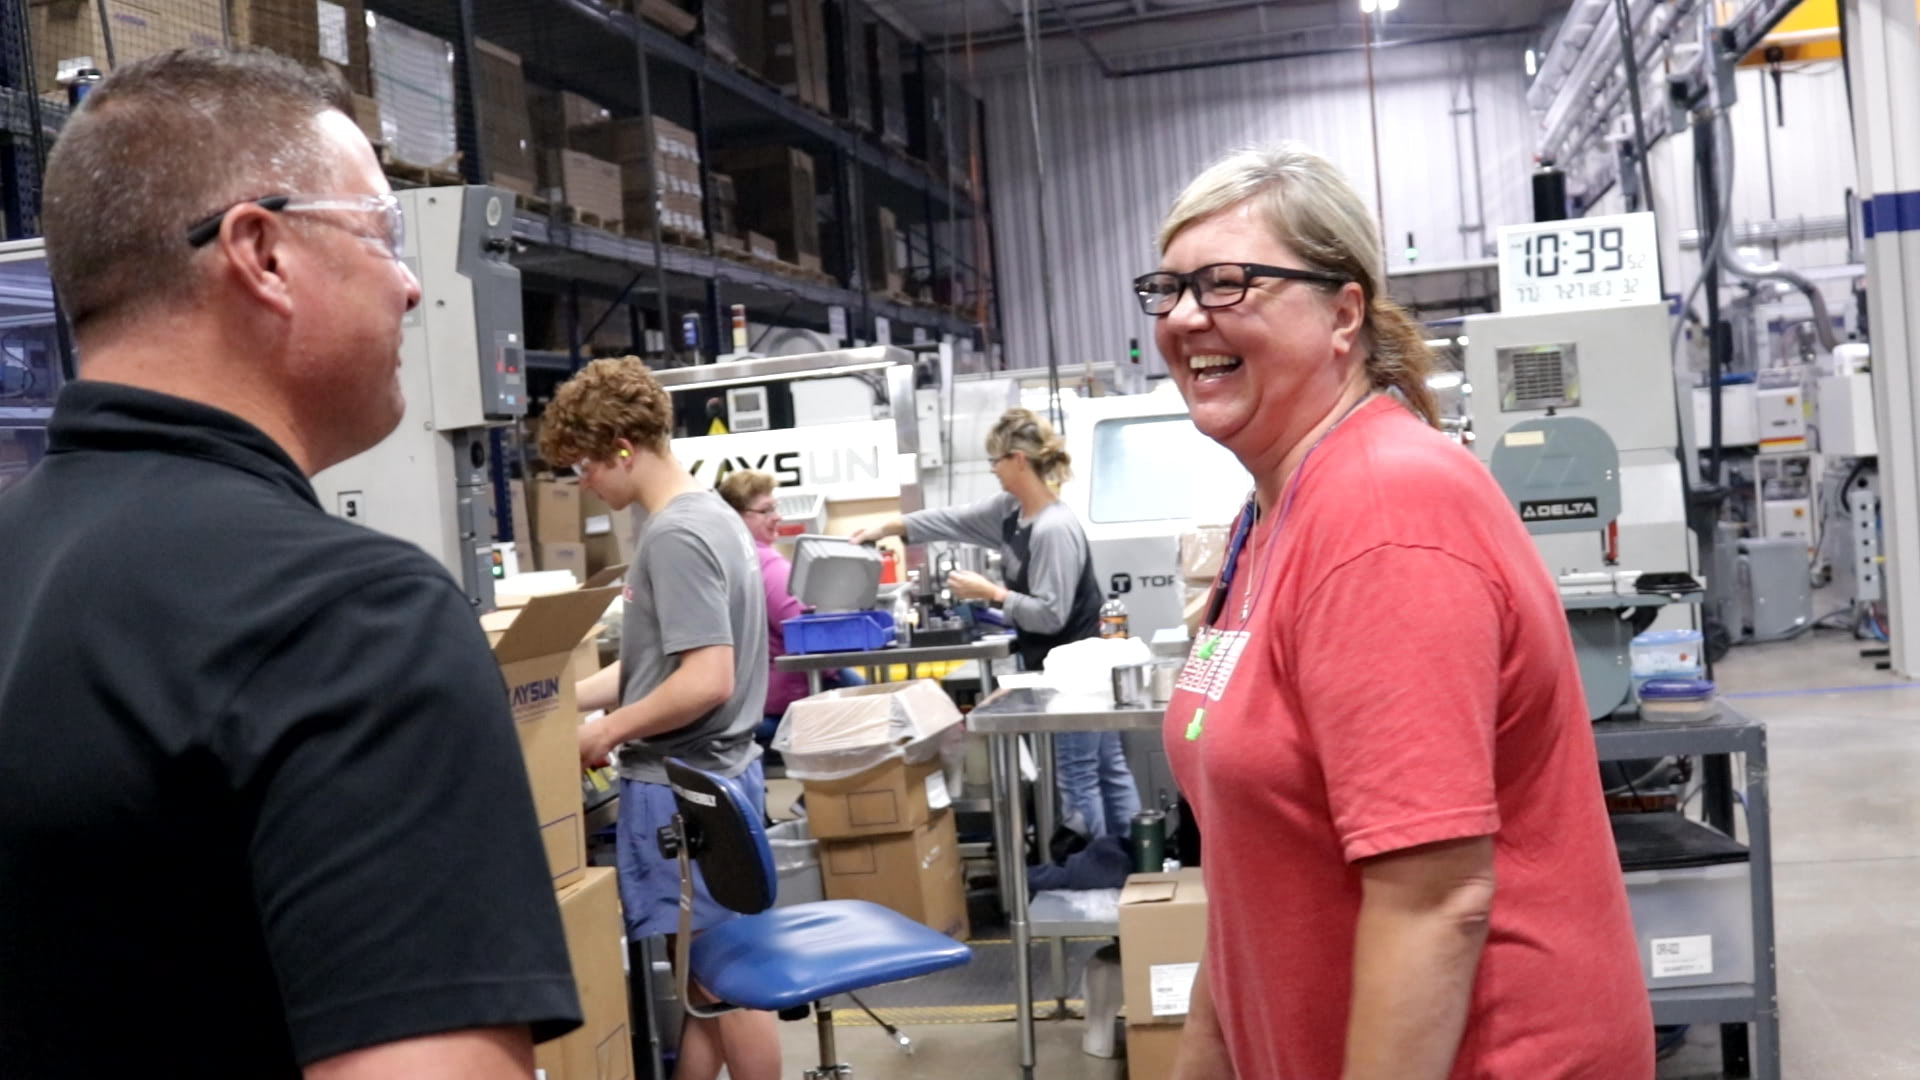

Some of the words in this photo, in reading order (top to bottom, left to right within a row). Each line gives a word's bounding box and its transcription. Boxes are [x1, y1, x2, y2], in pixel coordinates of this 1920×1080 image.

[1525, 227, 1623, 277] 10:39
[689, 445, 879, 489] AYSUN
[1536, 502, 1596, 517] DELTA
[507, 676, 559, 706] AYSUN
